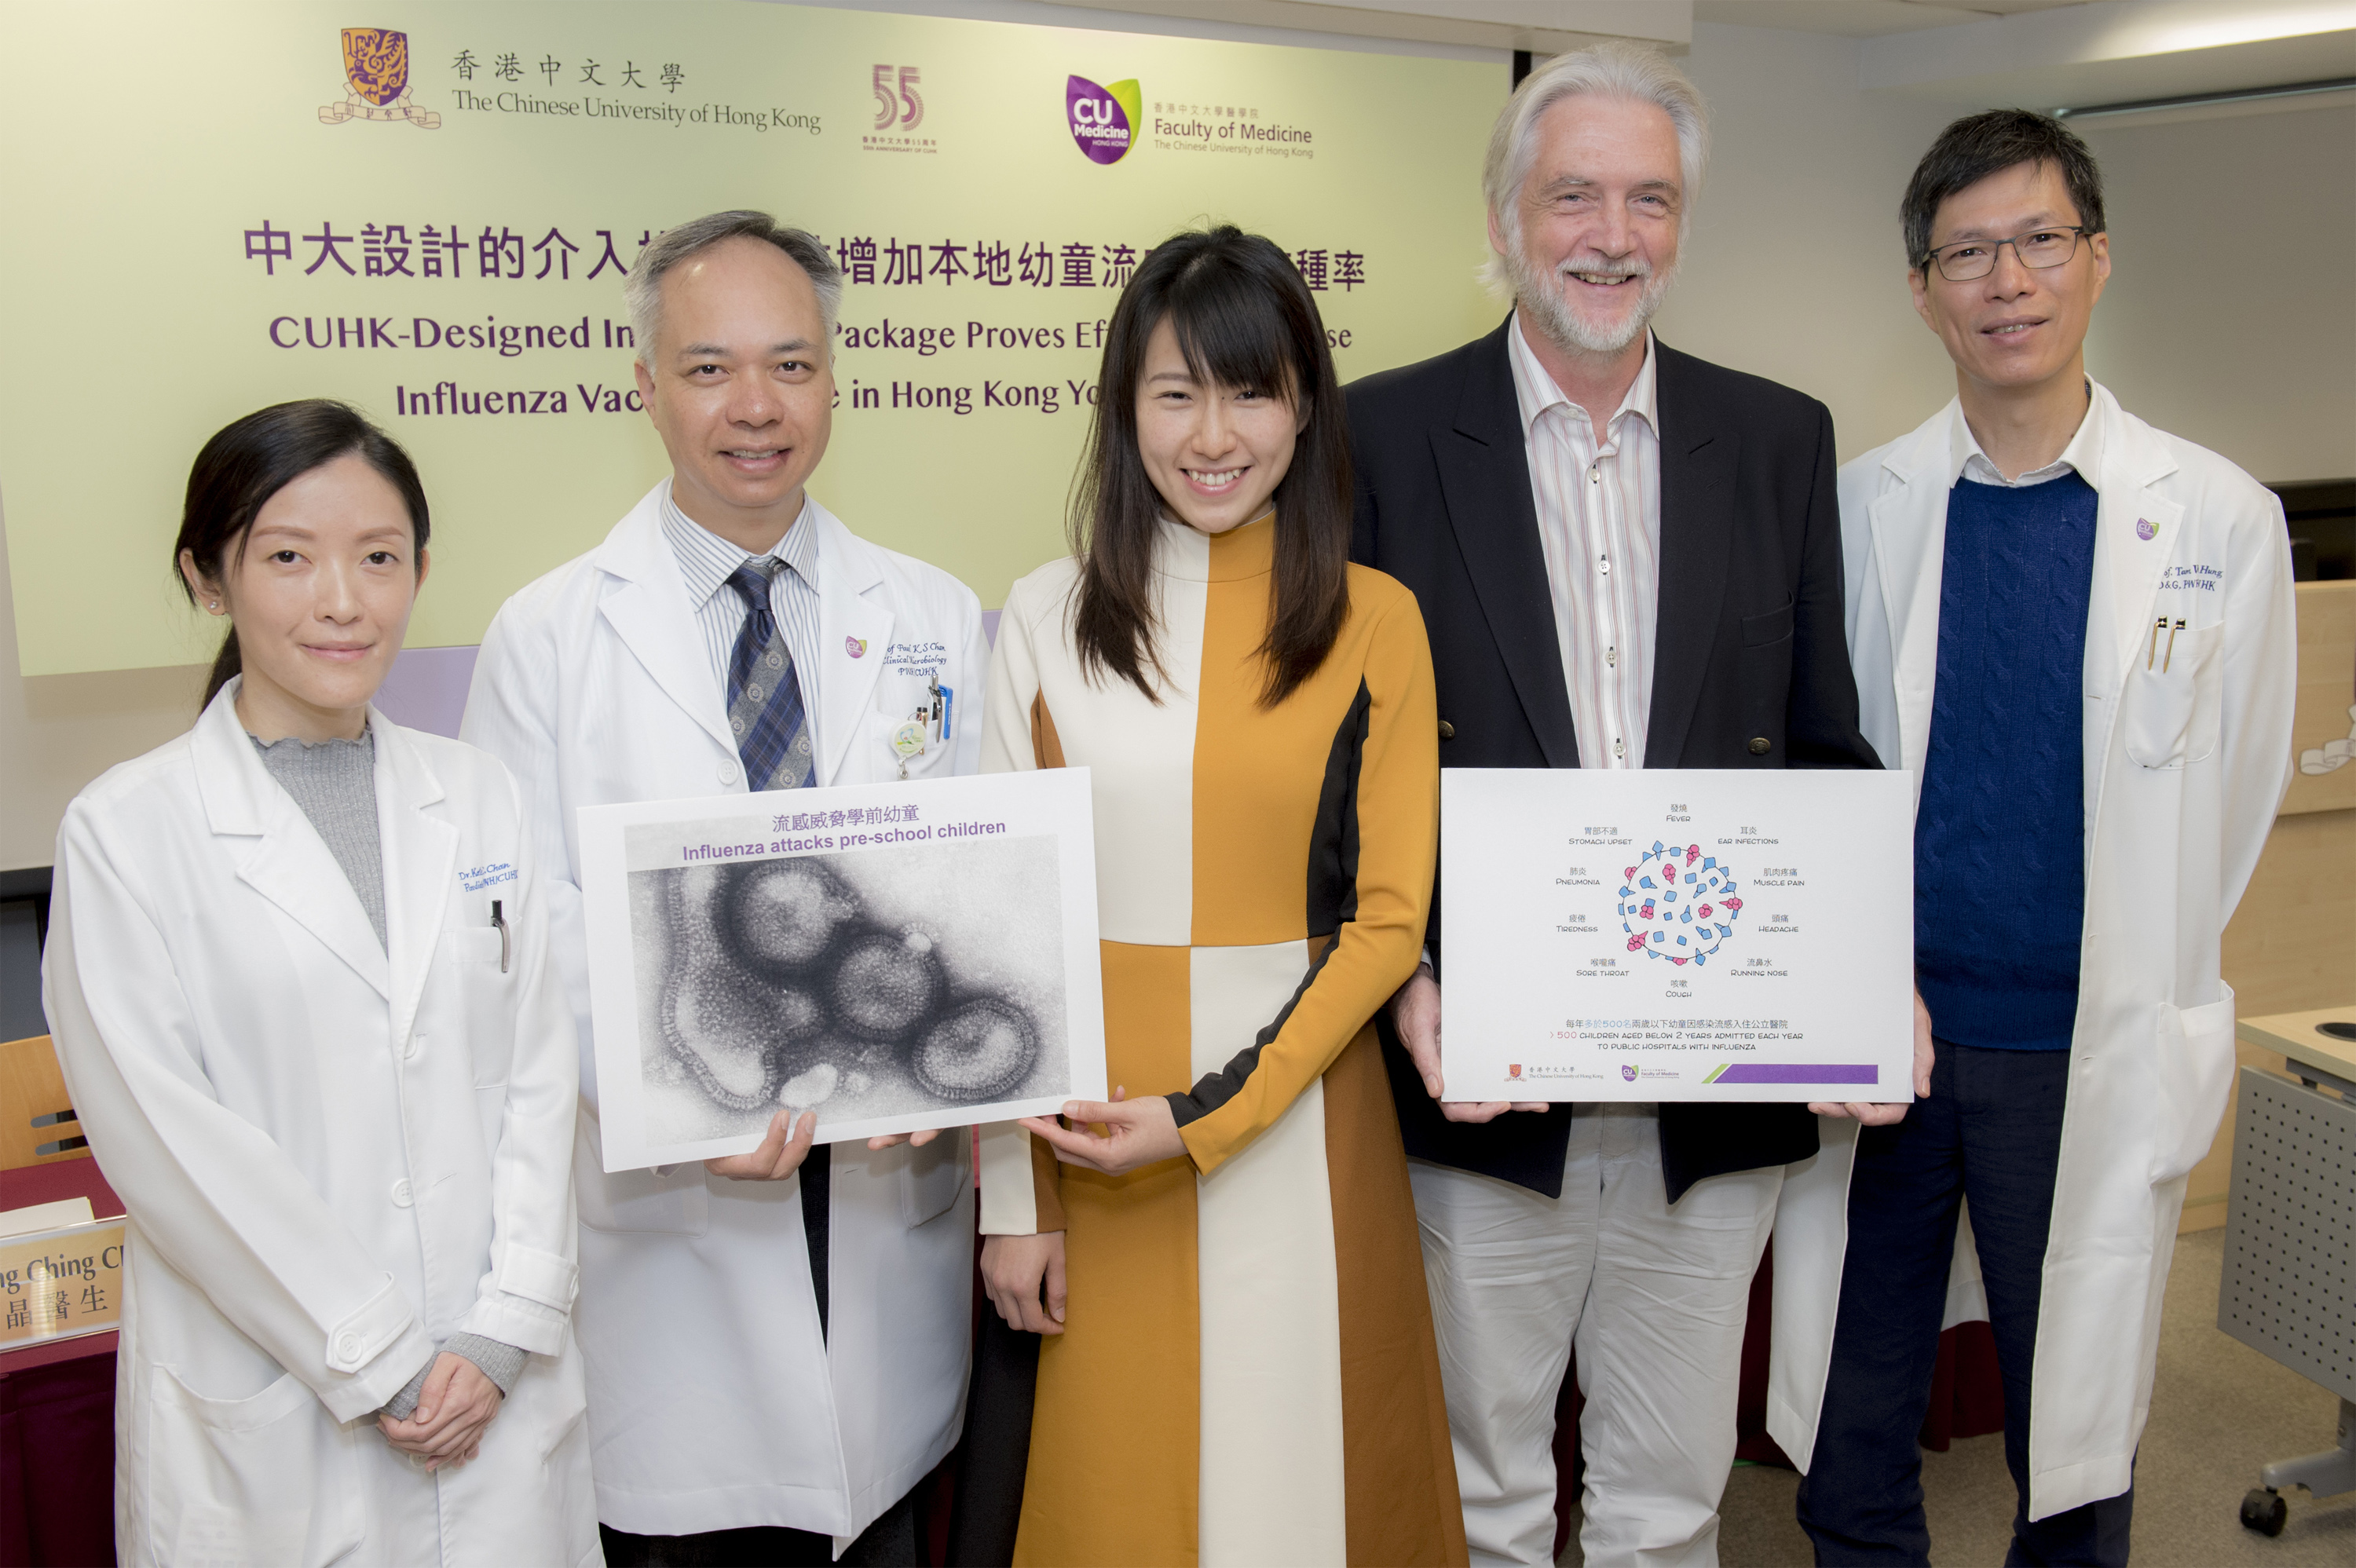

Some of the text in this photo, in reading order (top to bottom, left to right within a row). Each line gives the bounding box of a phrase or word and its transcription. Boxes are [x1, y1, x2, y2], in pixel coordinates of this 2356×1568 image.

[451, 49, 686, 93] 香港中文大學
[452, 89, 821, 134] The Chinese University of Hong Kong
[1074, 97, 1113, 125] CU
[1154, 102, 1260, 119] 香港中文大學醫學院
[1074, 123, 1129, 140] Medicine
[1155, 119, 1312, 144] Faculty of Medicine
[1154, 139, 1314, 159] The Chinese University of Hong Kong
[243, 219, 1366, 293] 中大設計的介入 增加本地幼童流 種率
[269, 316, 591, 357] CUHK-Designed
[604, 319, 635, 348] In
[968, 320, 1066, 350] Proves
[1075, 318, 1108, 349] Ef
[1326, 329, 1352, 349] se
[397, 382, 568, 416] Influenza
[576, 384, 645, 413] Vac
[852, 378, 880, 409] in
[892, 380, 973, 415] Hong
[984, 378, 1059, 414] Kong
[1066, 379, 1099, 406] Yo
[2164, 567, 2173, 578] of.
[913, 644, 922, 653] K
[923, 642, 928, 652] S
[930, 641, 946, 651] Chan
[1670, 803, 1688, 813] 發燒
[771, 804, 921, 834] 流感威脅學前幼童
[1584, 827, 1618, 835] 胃部不適
[1740, 826, 1757, 835] 耳炎
[682, 820, 1006, 862] Influenza attacks pre-school children
[487, 863, 510, 873] Chan
[1569, 867, 1586, 876] 肺炎
[1763, 868, 1798, 877] 肌肉疼痛
[1569, 914, 1586, 923] 疲倦
[1772, 914, 1789, 923] 頭痛
[1590, 958, 1616, 967] 喉嚨痛
[1747, 958, 1772, 967] 流鼻水
[27, 1253, 96, 1282] Ching
